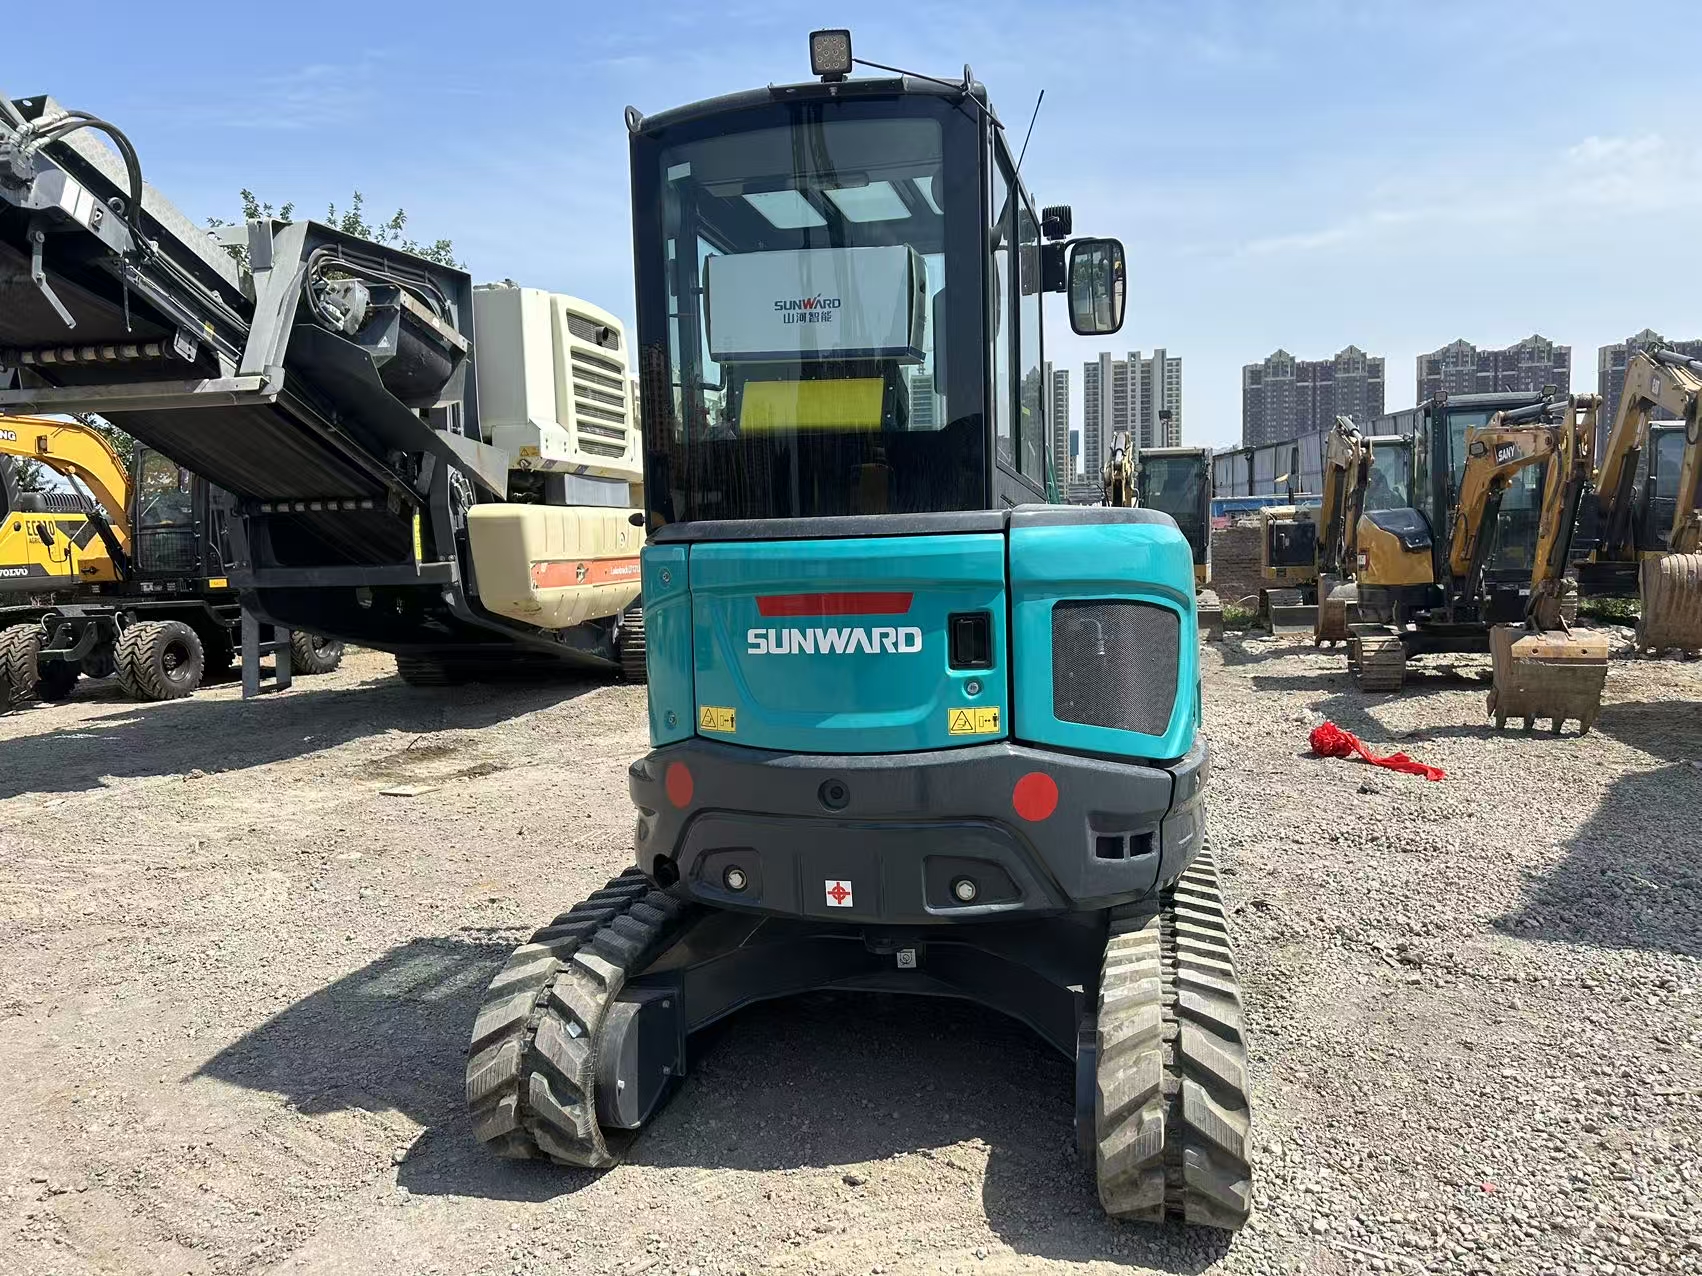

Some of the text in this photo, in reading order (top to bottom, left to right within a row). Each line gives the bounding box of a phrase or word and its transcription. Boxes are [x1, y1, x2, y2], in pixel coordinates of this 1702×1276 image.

[774, 293, 841, 311] SUNWARD
[783, 310, 832, 324] 山河智能
[1498, 444, 1515, 462] SANY
[747, 626, 923, 655] SUNWARD
